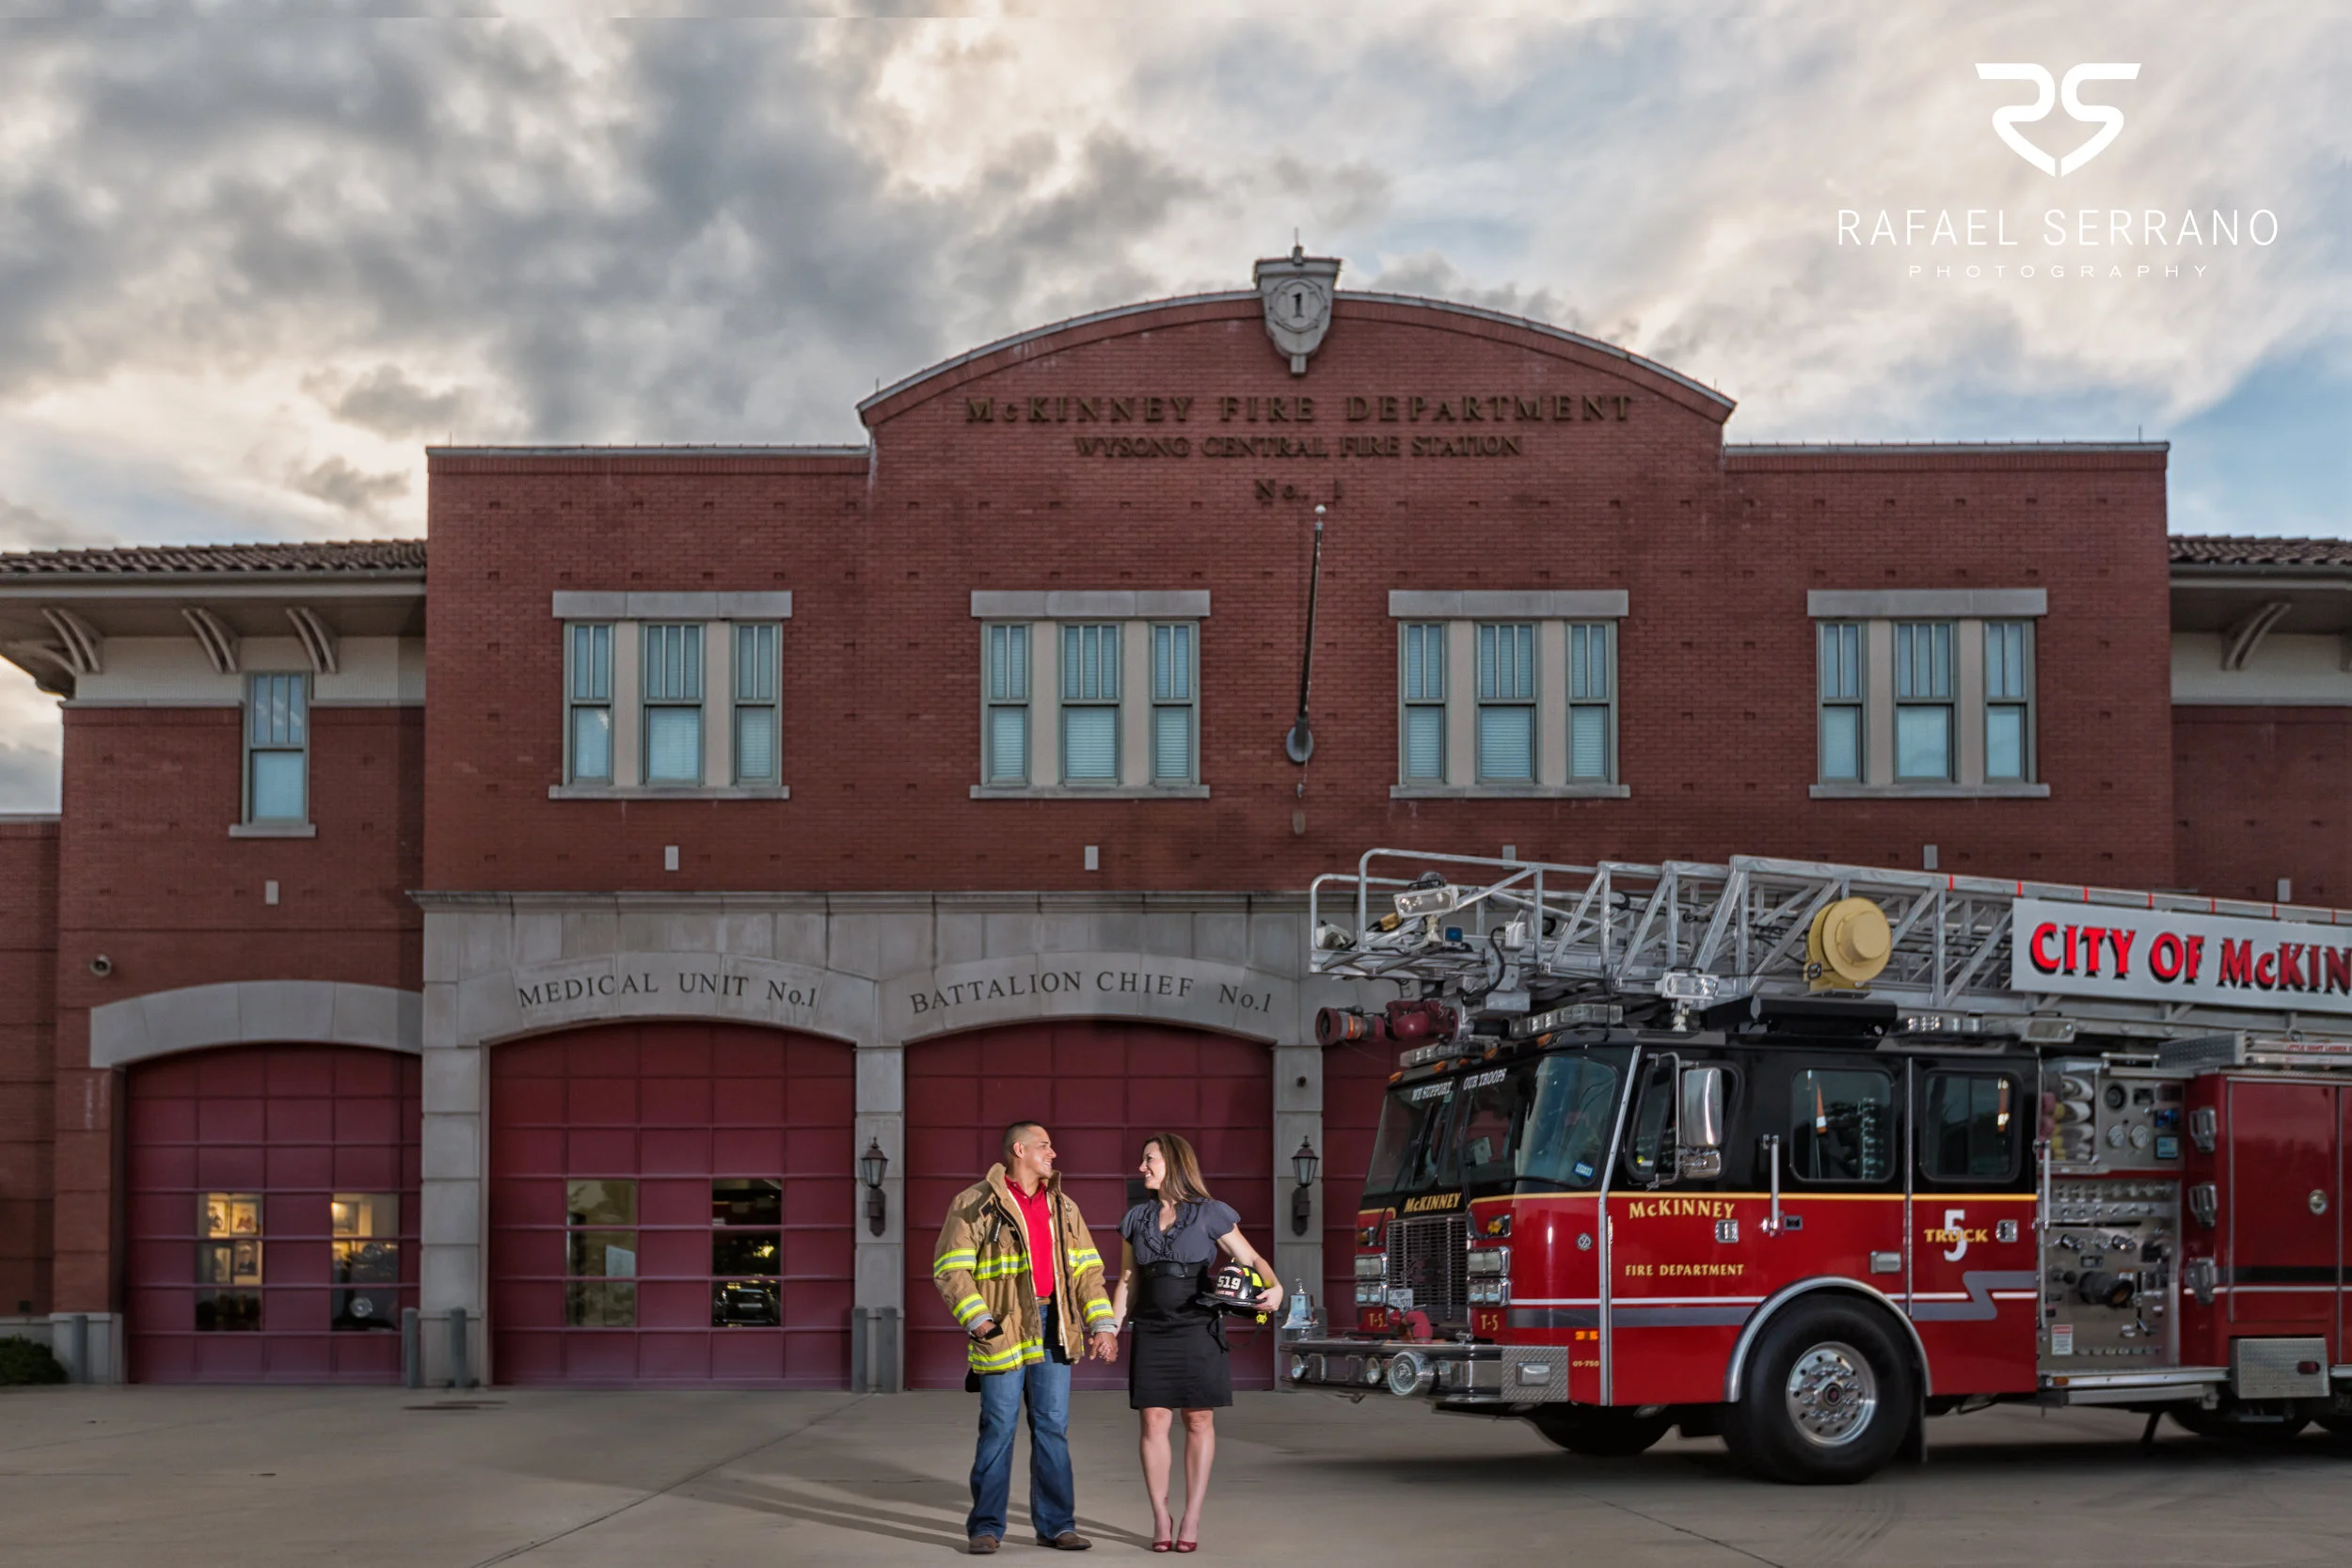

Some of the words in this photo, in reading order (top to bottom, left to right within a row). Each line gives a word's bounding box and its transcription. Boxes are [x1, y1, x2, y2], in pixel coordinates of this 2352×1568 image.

[1292, 293, 1304, 318] 1
[965, 396, 1194, 422] McKINNEY
[1220, 396, 1314, 422] FIRE
[1346, 395, 1631, 421] DEPARTMENT
[1073, 436, 1189, 458] WYSONG
[1201, 436, 1328, 458] CENTRAL
[1340, 436, 1400, 457] FIRE
[1412, 436, 1522, 457] STATION
[2030, 922, 2136, 979] CITY
[2149, 932, 2204, 985] OF
[2217, 938, 2352, 995] McKIN
[518, 974, 658, 1009] MEDICAL
[678, 972, 749, 997] UNIT
[911, 972, 1082, 1014] BATTALION
[1096, 972, 1194, 997] CHIEF
[1422, 1081, 1453, 1099] SUPPORT
[1463, 1074, 1479, 1091] OUR
[1478, 1068, 1507, 1087] TROOPS
[1404, 1192, 1462, 1212] McKINNEY
[1629, 1199, 1735, 1219] McKINNEY
[1923, 1228, 1989, 1243] TRUCK
[1944, 1209, 1968, 1262] 5
[1625, 1264, 1653, 1276] FIRE
[1659, 1264, 1744, 1276] DEPARTMENT
[1216, 1275, 1241, 1291] 519
[1369, 1312, 1384, 1328] T-5
[1480, 1314, 1499, 1332] T-5
